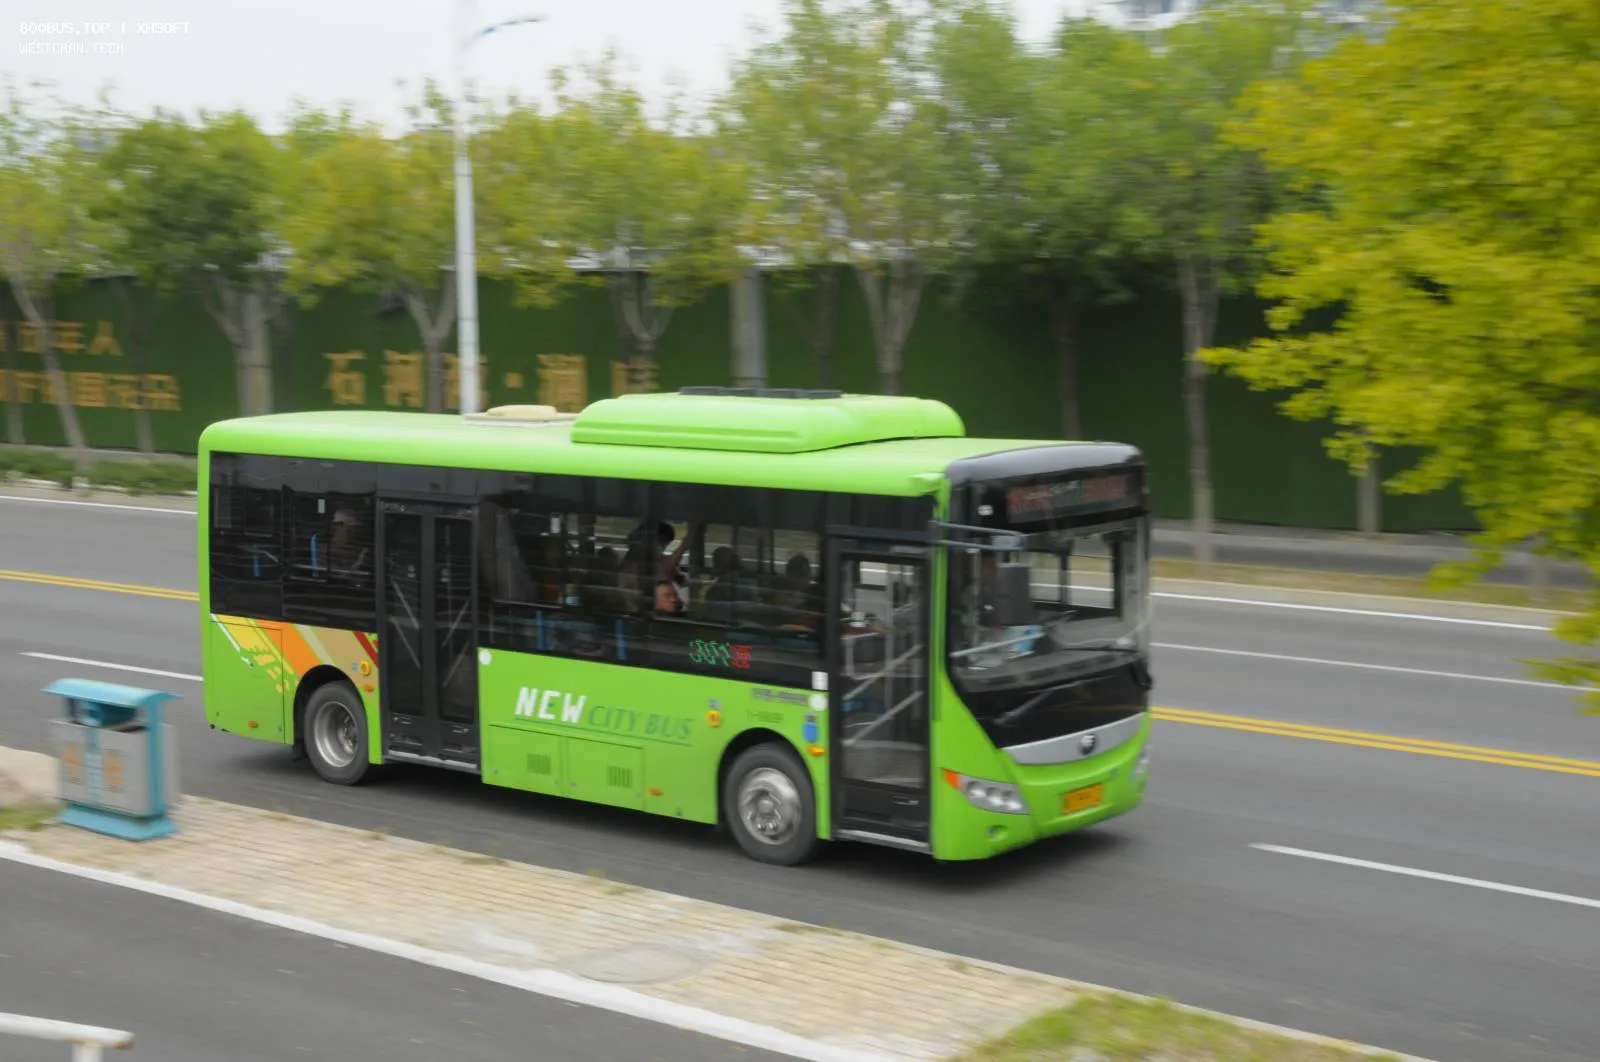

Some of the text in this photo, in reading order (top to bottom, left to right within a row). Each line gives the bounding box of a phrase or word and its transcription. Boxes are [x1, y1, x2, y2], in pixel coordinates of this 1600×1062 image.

[514, 686, 693, 740] NEW CITY BUS
